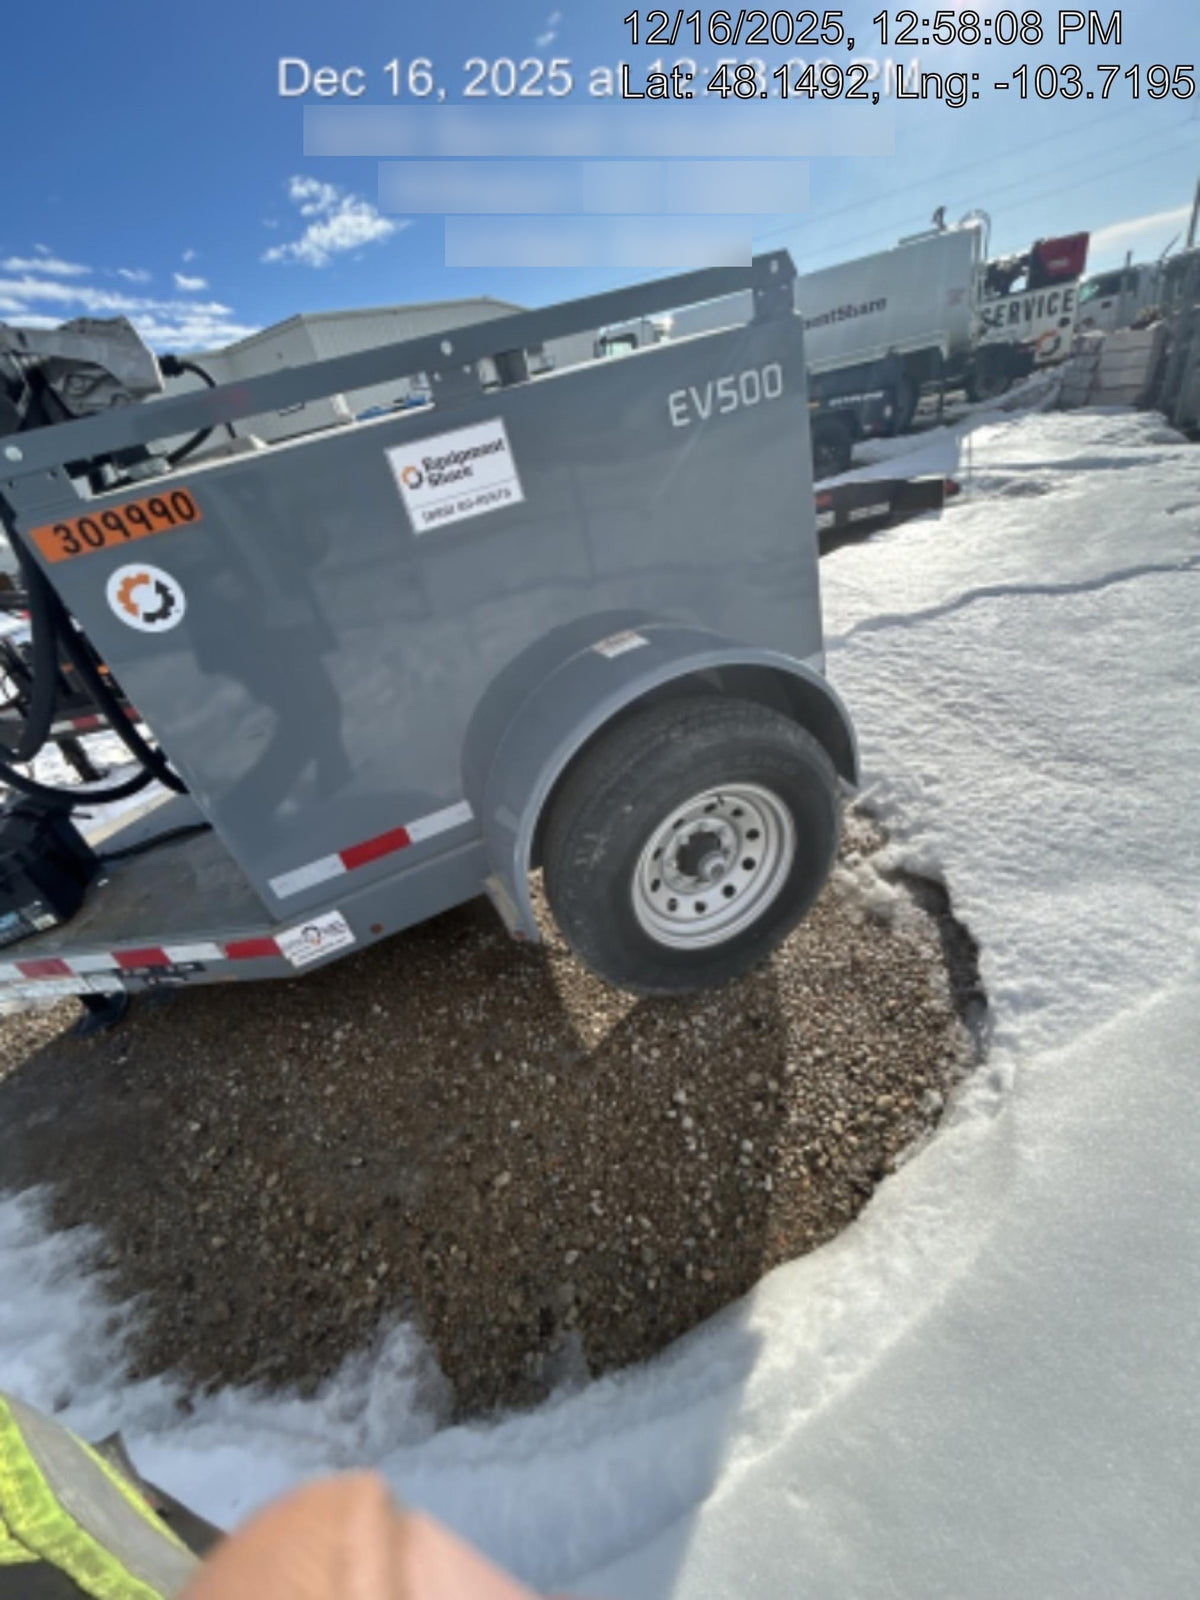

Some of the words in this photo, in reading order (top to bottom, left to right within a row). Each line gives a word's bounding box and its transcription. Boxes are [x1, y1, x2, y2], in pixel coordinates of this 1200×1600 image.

[981, 287, 1076, 328] SERVICE
[668, 362, 783, 427] EV500
[53, 490, 196, 554] 309990
